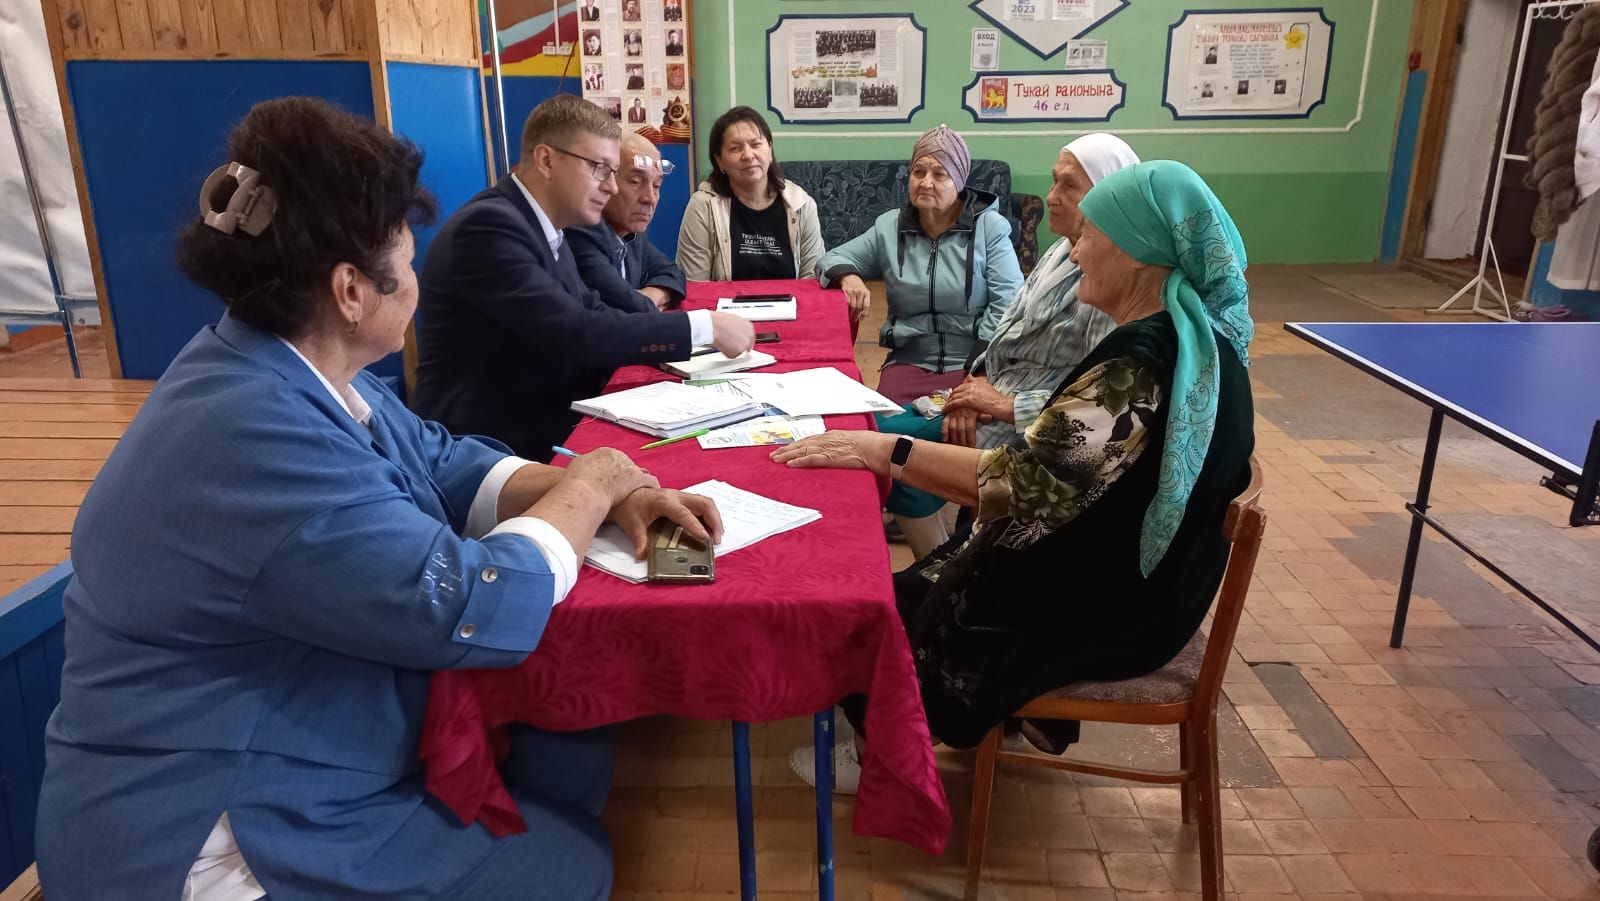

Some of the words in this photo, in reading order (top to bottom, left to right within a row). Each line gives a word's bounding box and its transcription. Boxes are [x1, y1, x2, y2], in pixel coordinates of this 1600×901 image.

[1011, 4, 1035, 14] 2023
[977, 33, 995, 41] ВХОД
[1014, 83, 1050, 97] Тукай
[1033, 100, 1048, 111] 46
[1054, 102, 1070, 111] ел
